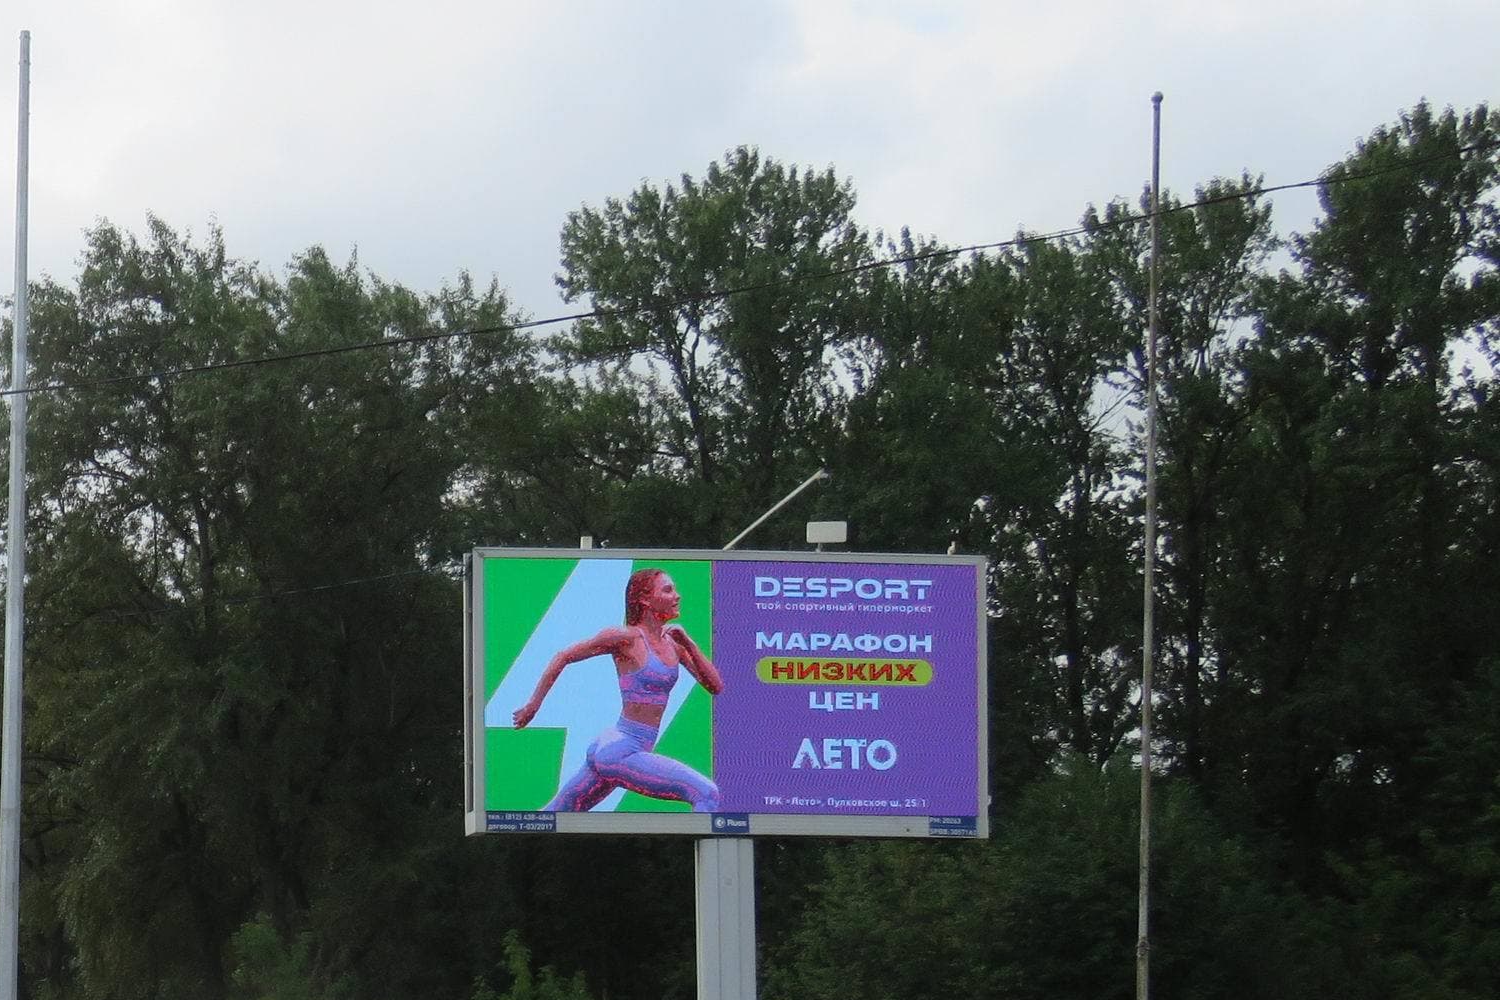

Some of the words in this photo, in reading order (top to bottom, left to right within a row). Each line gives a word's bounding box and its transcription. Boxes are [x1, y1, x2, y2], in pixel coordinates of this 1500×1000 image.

[754, 576, 933, 600] DESPORT
[785, 602, 854, 613] спортивный
[857, 604, 933, 615] гипермаркет
[755, 631, 933, 653] МАРАФОН
[771, 661, 917, 682] НИЗКИХ
[808, 691, 880, 712] ЦЕН
[791, 737, 897, 771] ЛЕТО
[763, 796, 782, 806] ТРК
[827, 797, 887, 808] Пулковское
